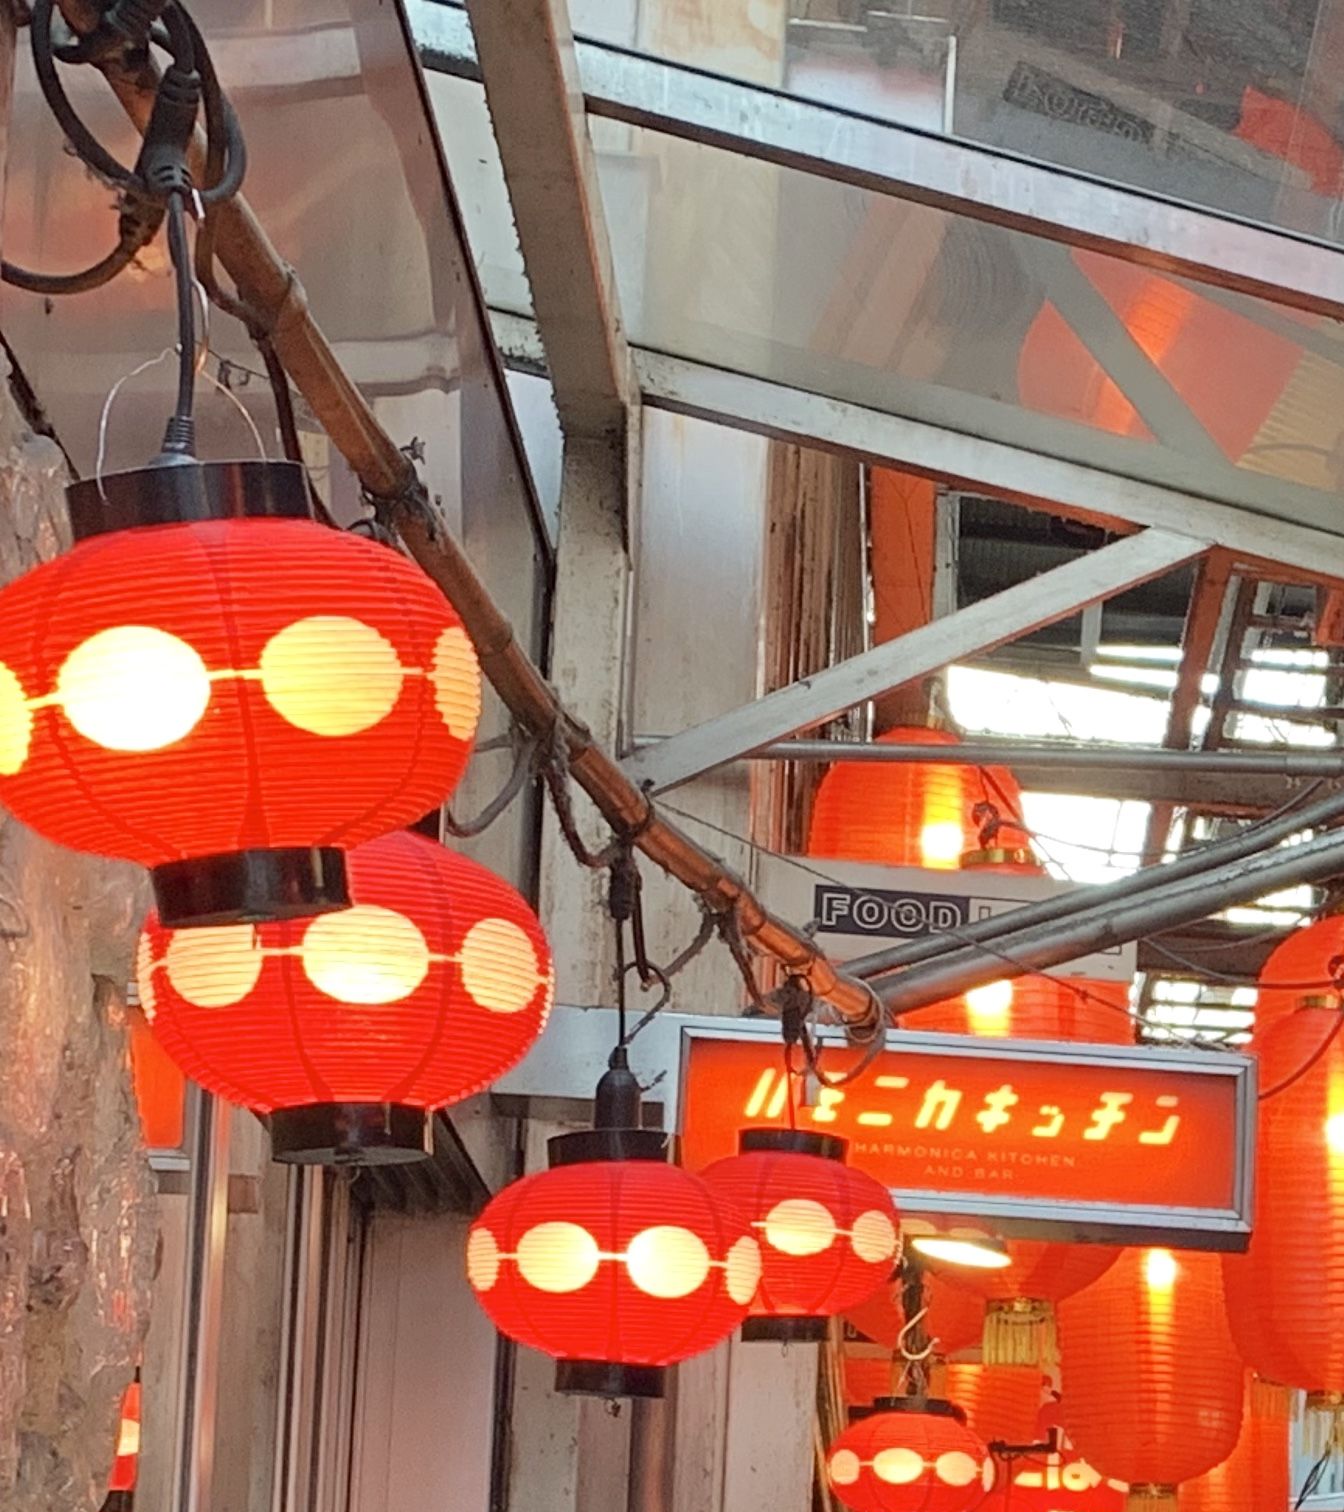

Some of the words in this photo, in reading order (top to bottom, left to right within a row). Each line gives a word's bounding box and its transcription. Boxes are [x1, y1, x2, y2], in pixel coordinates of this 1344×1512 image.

[821, 892, 962, 934] FOOD
[853, 1142, 978, 1162] HARMONICA
[986, 1150, 1076, 1168] KITCHEN
[923, 1164, 969, 1178] AND
[974, 1167, 1016, 1181] BAR
